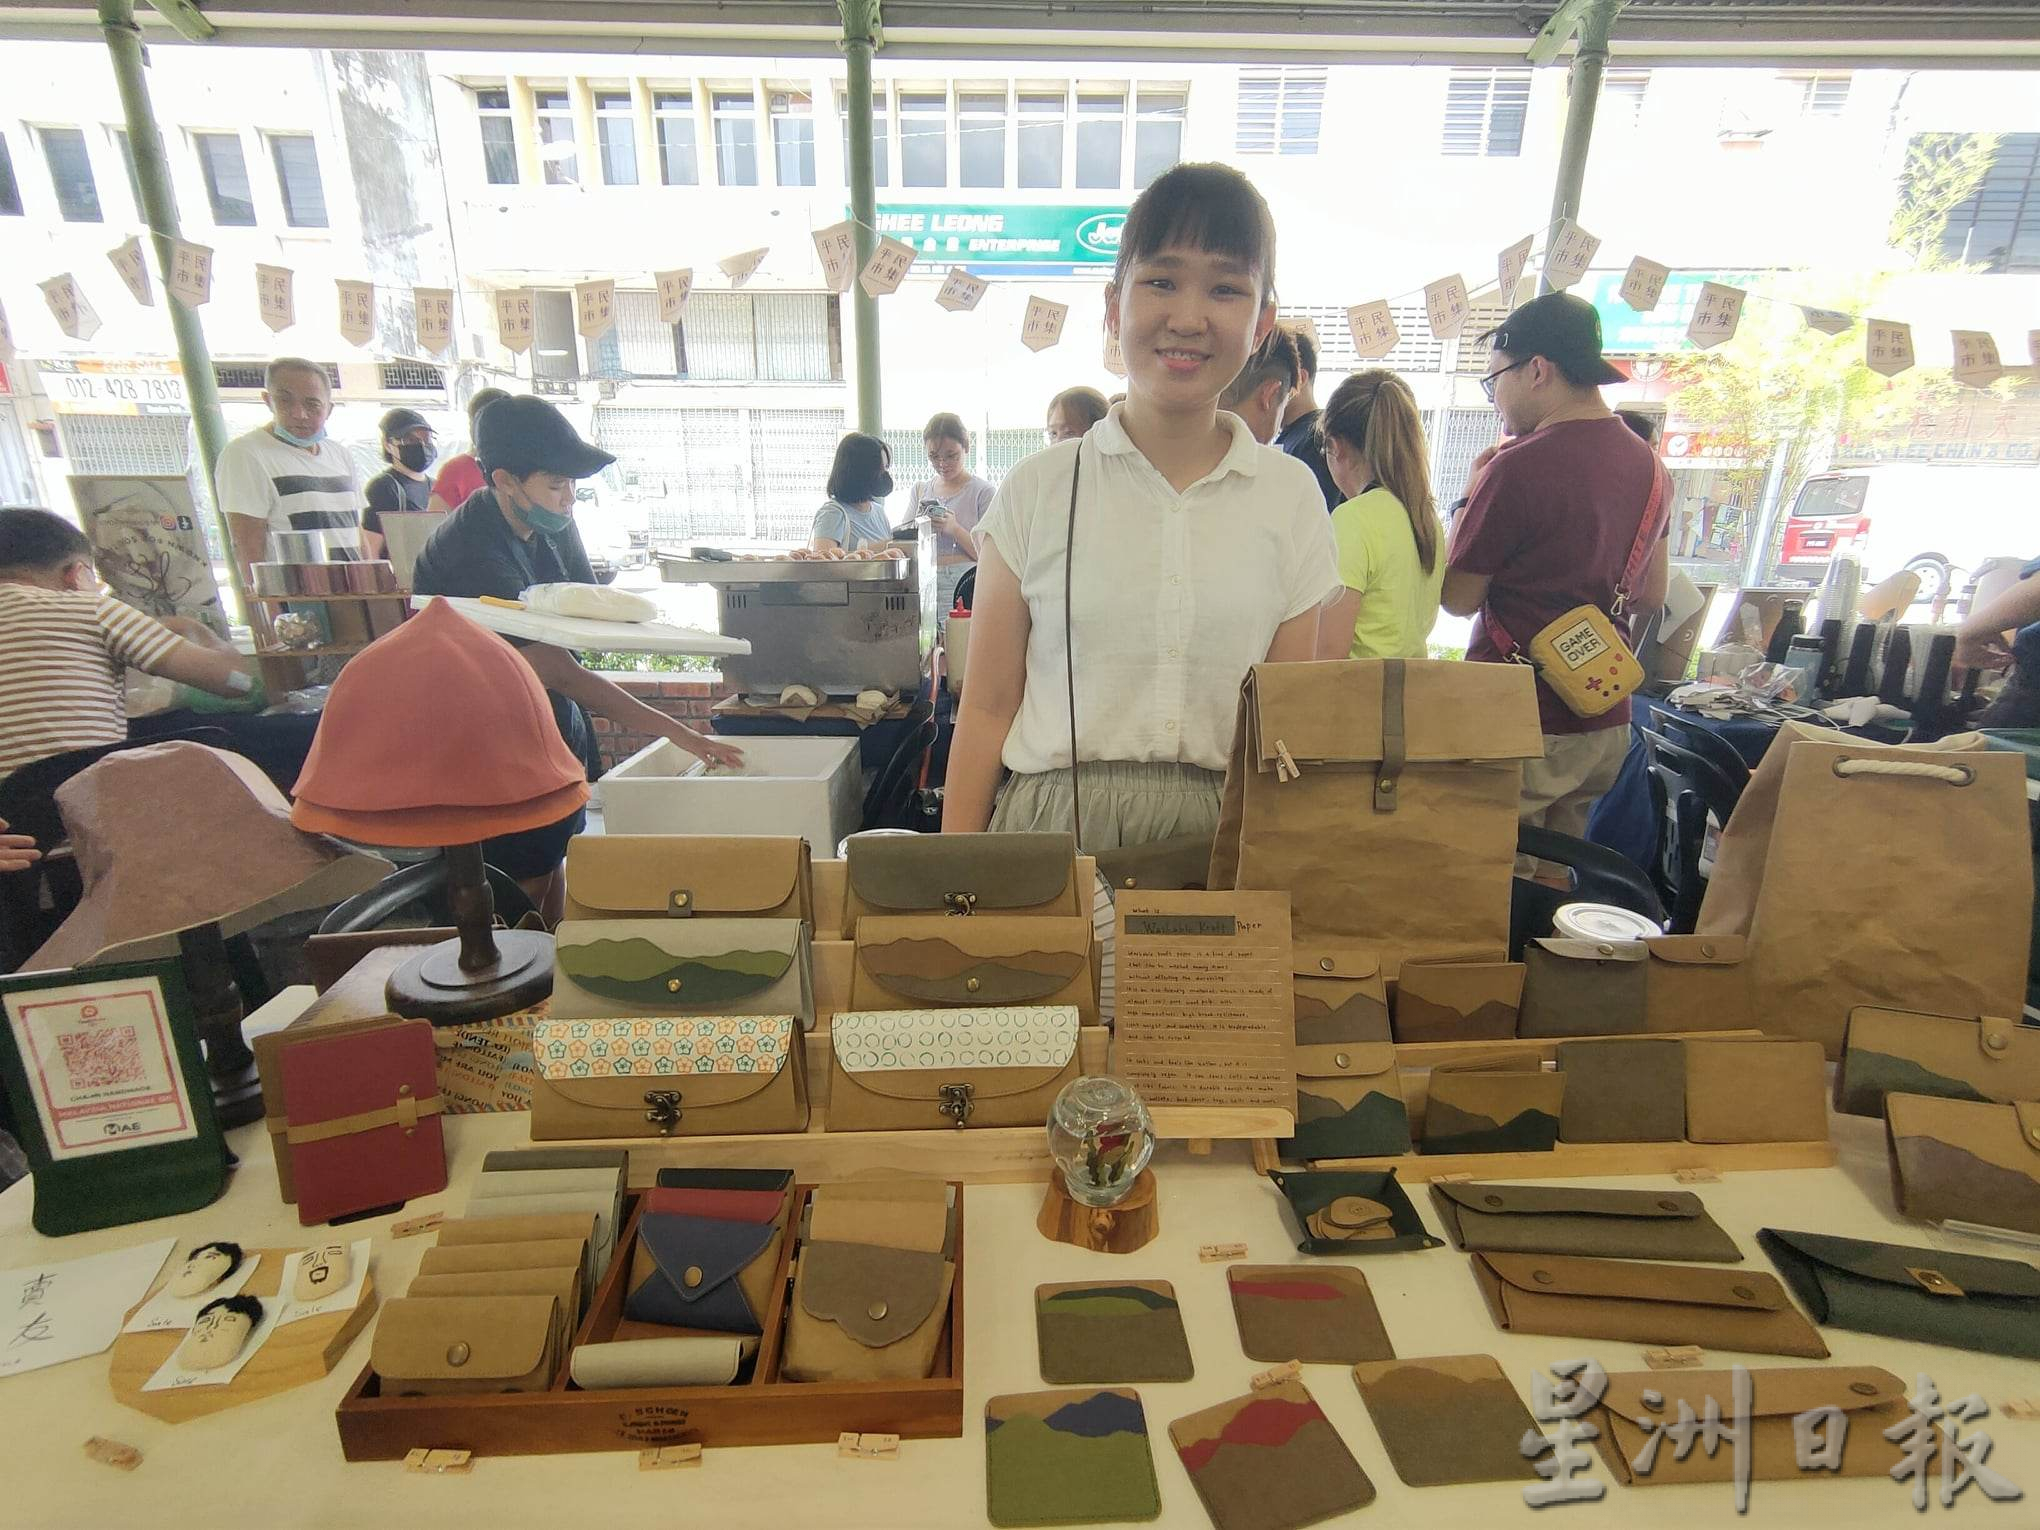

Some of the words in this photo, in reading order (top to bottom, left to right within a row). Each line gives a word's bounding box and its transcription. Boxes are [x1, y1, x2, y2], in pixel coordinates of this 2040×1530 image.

[930, 213, 1005, 232] LEONG
[821, 234, 849, 255] 平民
[1563, 230, 1596, 253] 平民
[880, 247, 908, 269] 平民
[1554, 248, 1588, 270] 市集
[583, 290, 610, 307] 平民
[1429, 284, 1459, 308] 平民
[1704, 292, 1738, 312] 平民
[421, 298, 449, 315] 平民
[501, 298, 530, 315] 平民
[1354, 311, 1385, 331] 平民
[1696, 311, 1733, 329] 市集
[142, 378, 182, 400] 7813
[1559, 626, 1595, 653] GAME
[1567, 638, 1602, 662] OVER
[1237, 920, 1262, 933] Paper
